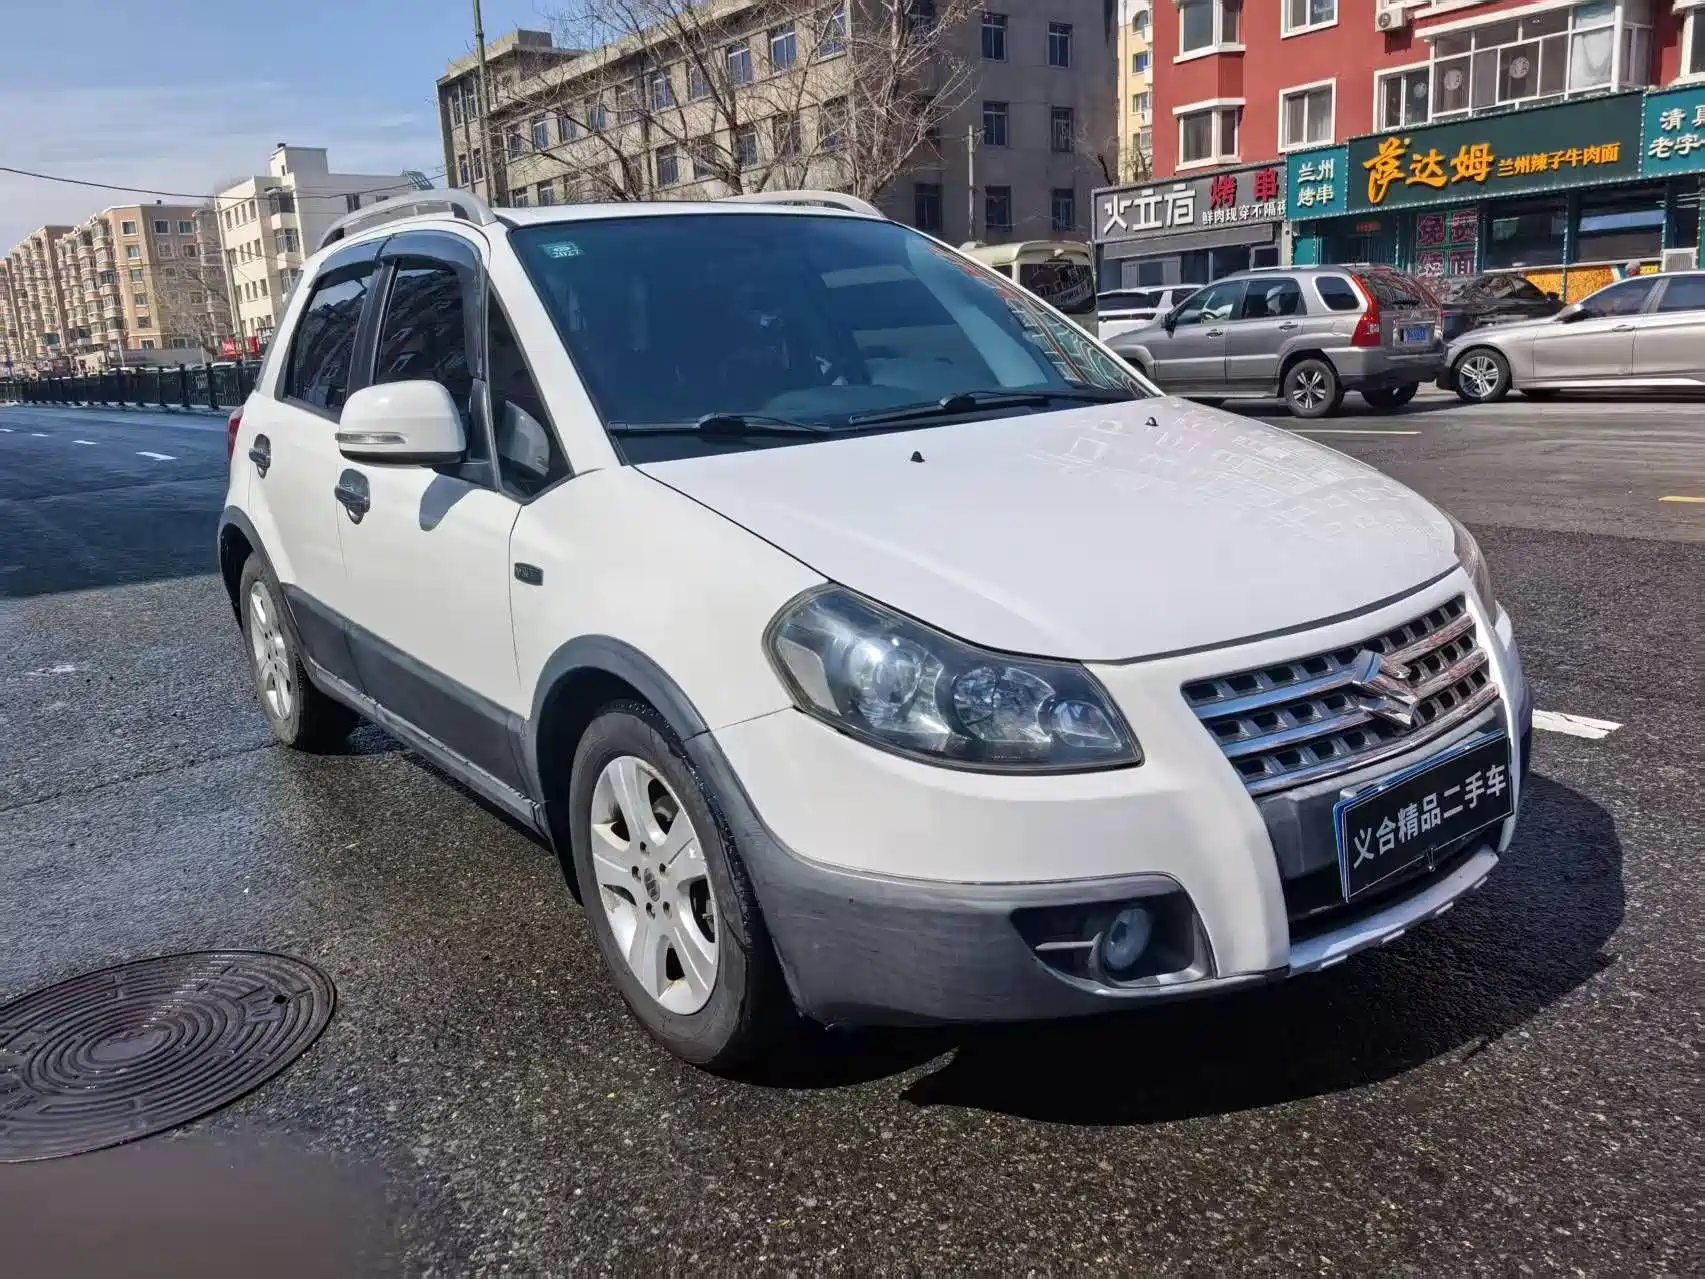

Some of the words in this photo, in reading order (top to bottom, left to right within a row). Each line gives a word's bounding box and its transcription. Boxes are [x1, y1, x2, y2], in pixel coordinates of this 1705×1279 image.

[1497, 141, 1621, 177] 兰州辣子牛肉面
[1648, 133, 1705, 158] 老字
[1208, 168, 1279, 209] 烤串
[1297, 158, 1335, 183] 兰州
[1362, 136, 1496, 205] 萨达姆
[1297, 184, 1335, 207] 烤串
[1353, 764, 1507, 869] 义合精品二手车
